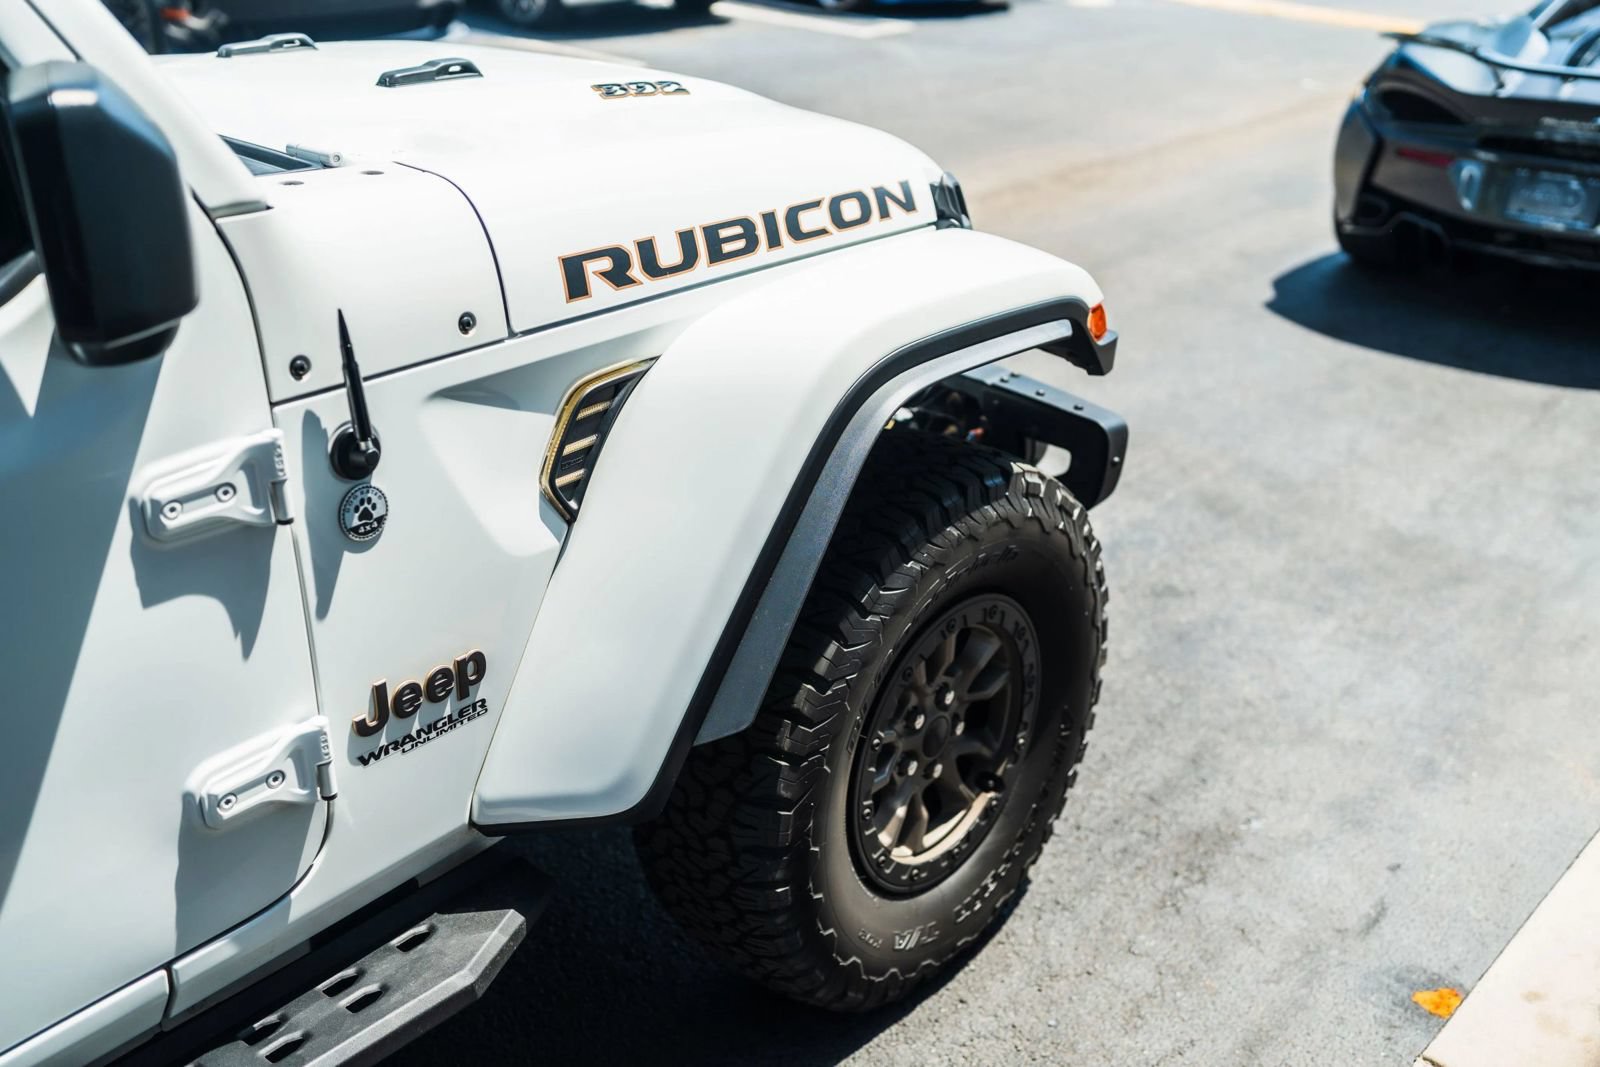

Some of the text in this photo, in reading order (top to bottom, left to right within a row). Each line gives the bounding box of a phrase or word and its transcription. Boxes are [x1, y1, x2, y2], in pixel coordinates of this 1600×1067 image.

[590, 81, 690, 99] 392
[558, 180, 918, 304] RUBICON
[351, 648, 487, 737] Jeep
[357, 698, 487, 766] WRANGLER
[402, 707, 488, 753] UNLIMITED
